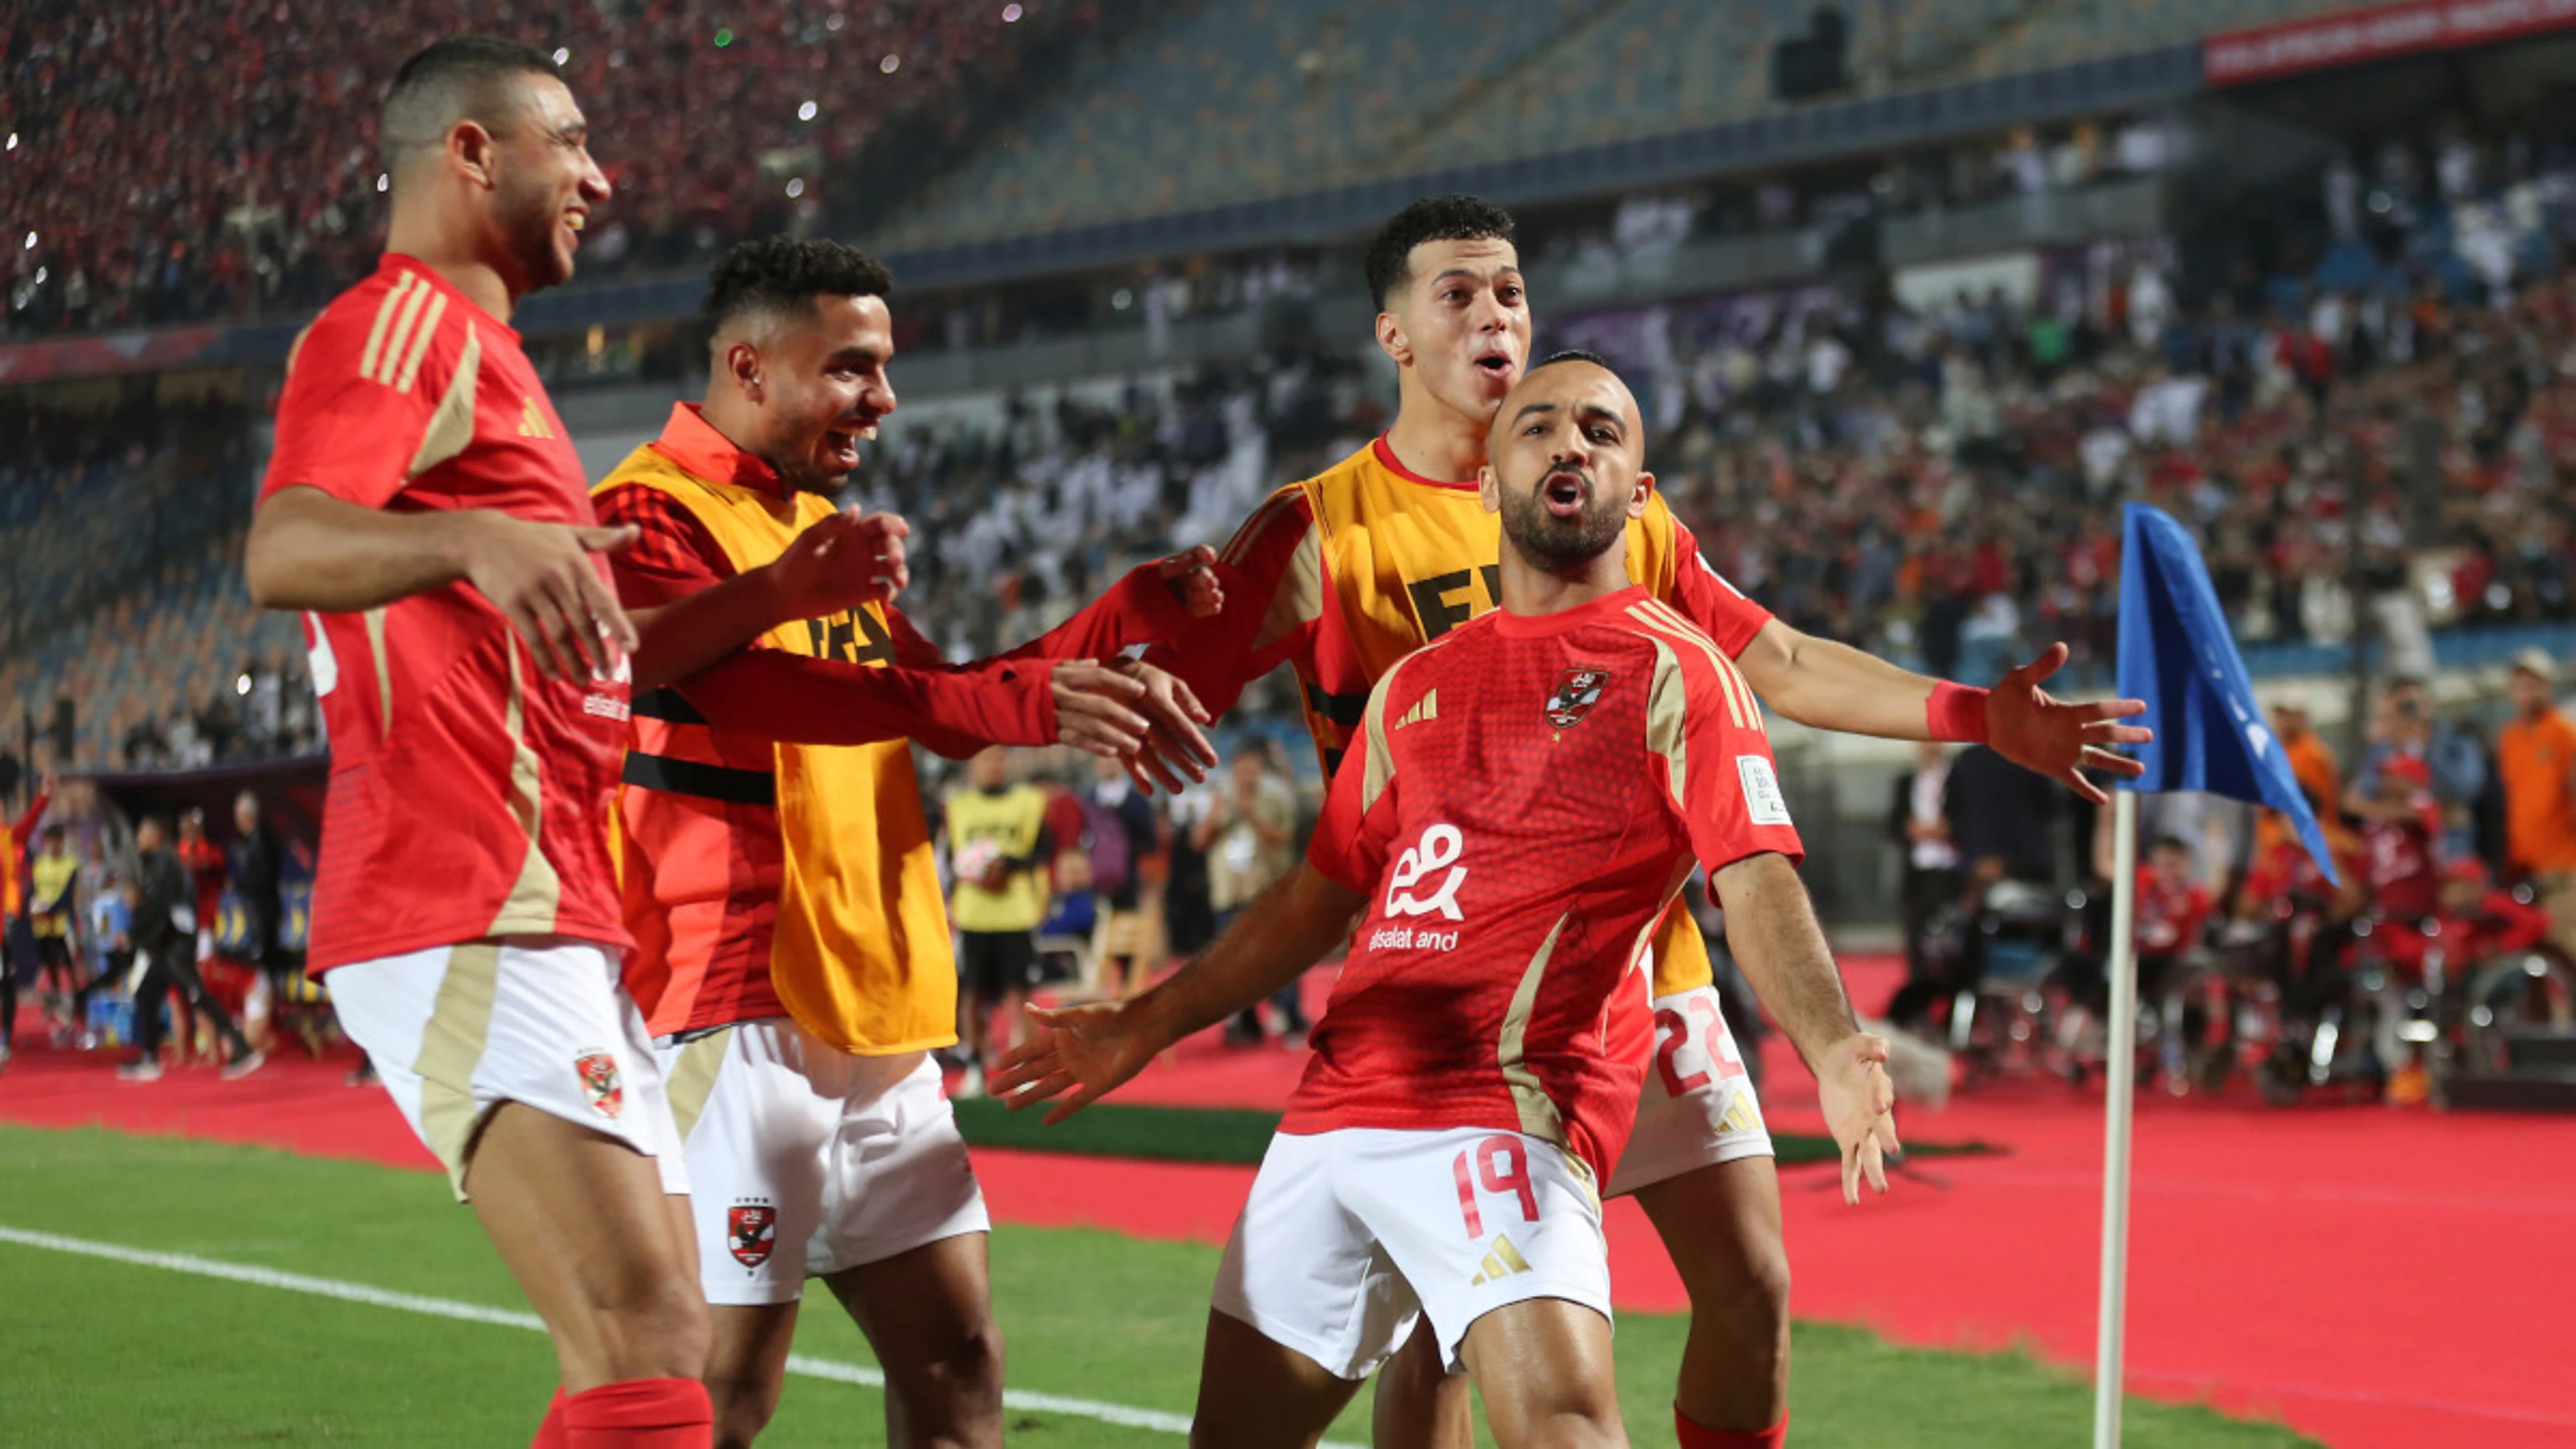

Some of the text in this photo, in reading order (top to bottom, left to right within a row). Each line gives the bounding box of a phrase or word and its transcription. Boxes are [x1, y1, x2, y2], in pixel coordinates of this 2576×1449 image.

[1415, 930, 1458, 951] and
[1655, 996, 1744, 1098] 22
[1453, 1134, 1540, 1240] 19
